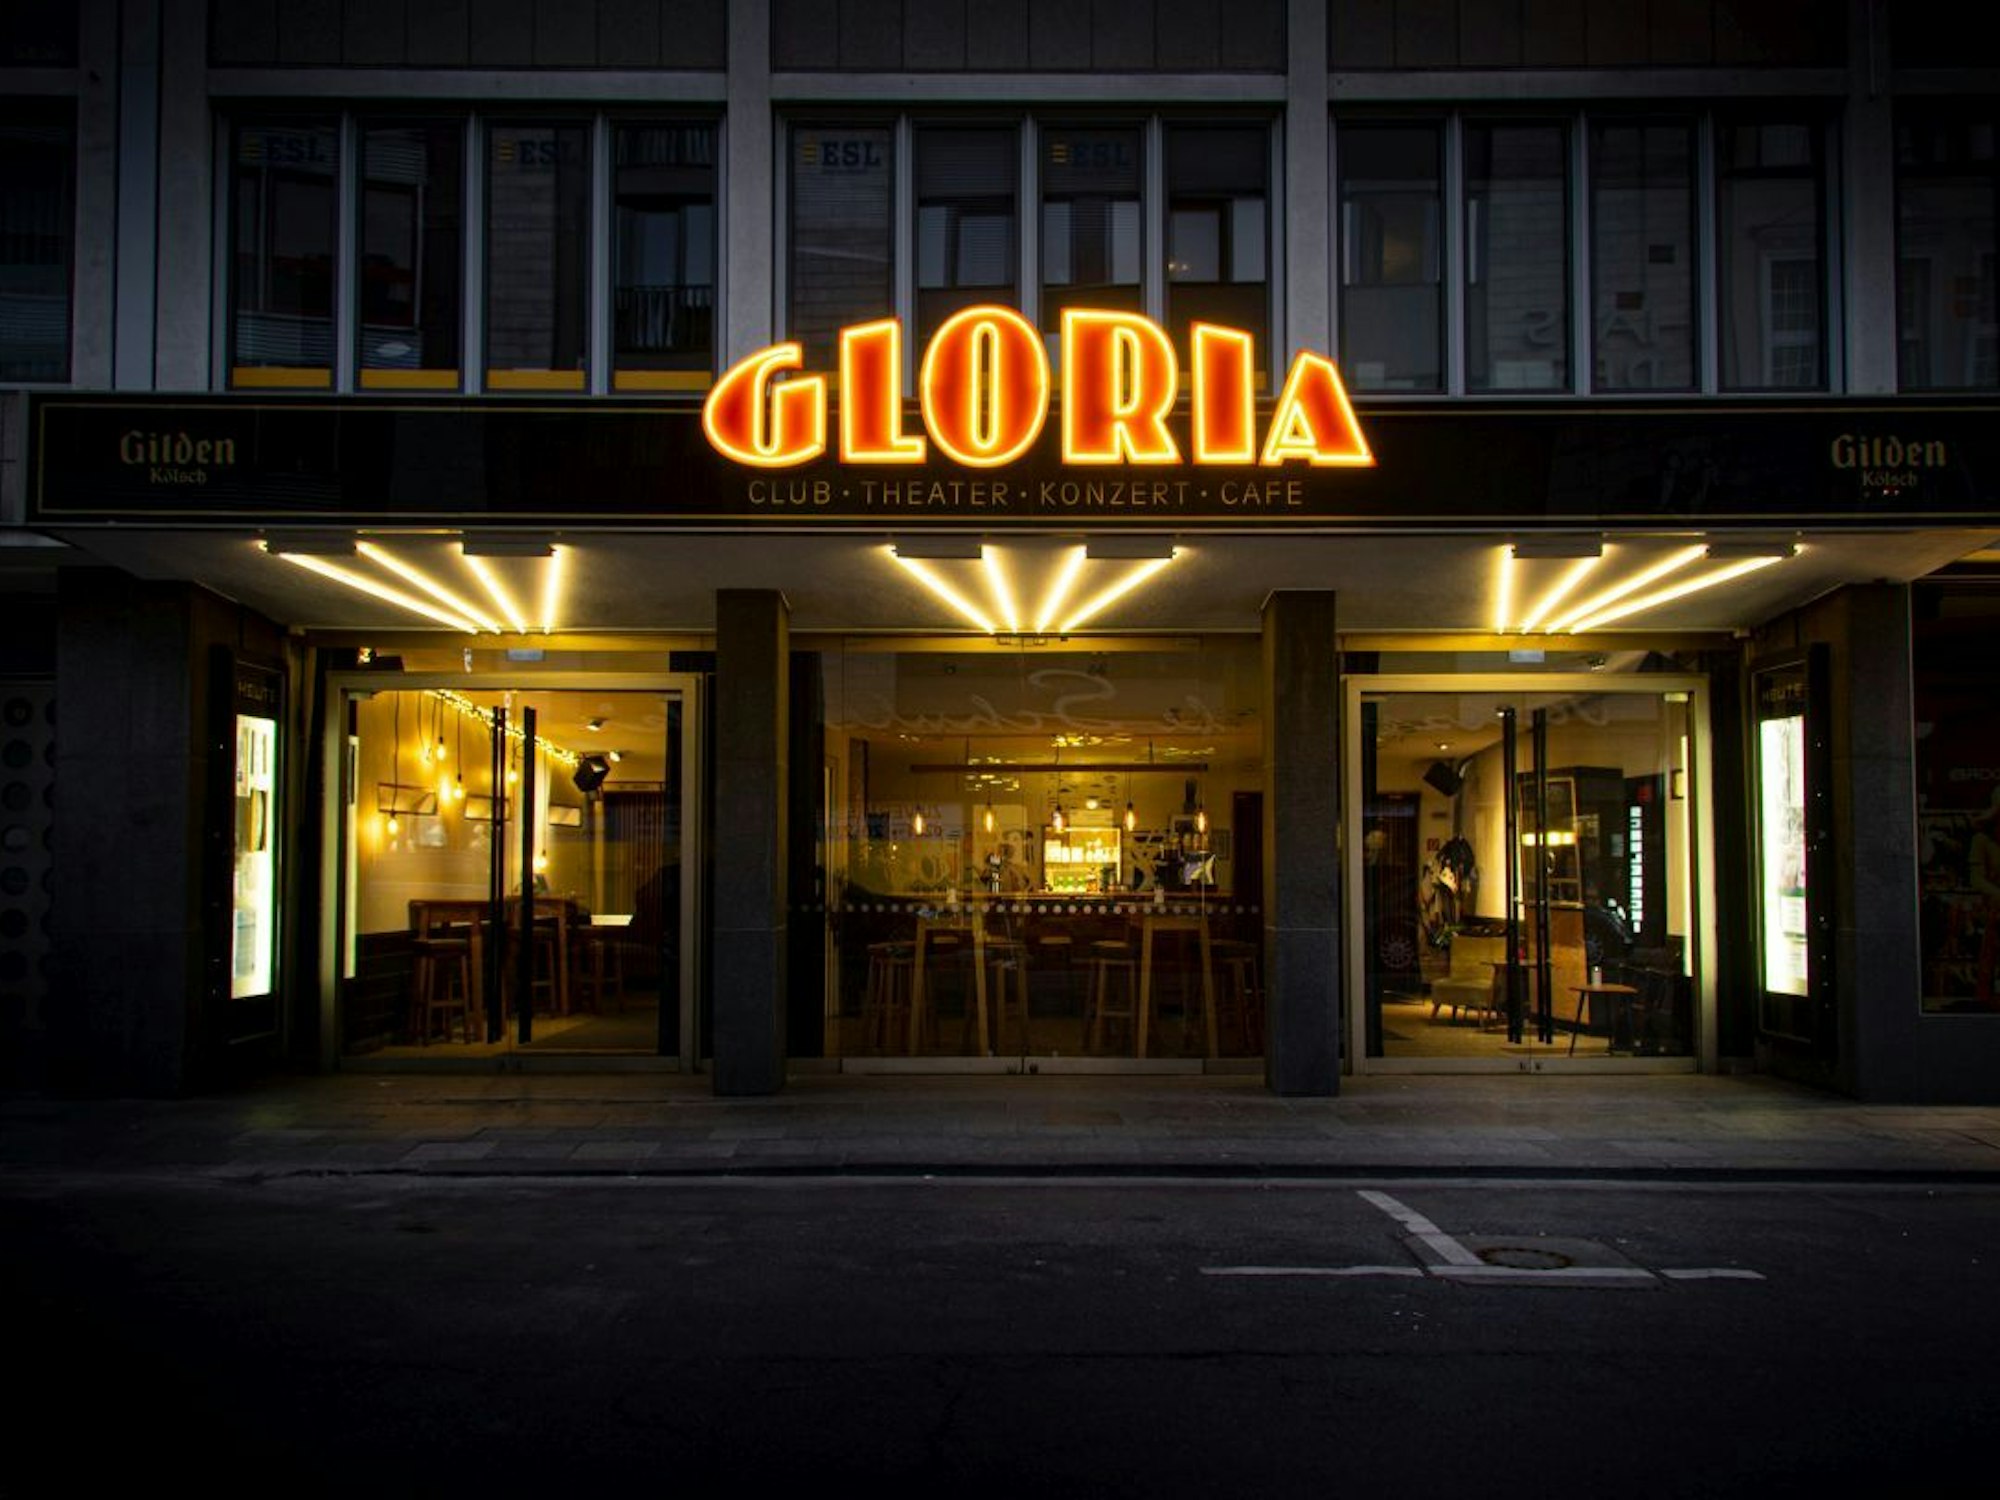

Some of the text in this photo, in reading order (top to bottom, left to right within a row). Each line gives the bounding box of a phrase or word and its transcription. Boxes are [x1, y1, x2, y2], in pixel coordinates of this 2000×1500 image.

[267, 135, 325, 162] ESL
[821, 140, 882, 166] ESL
[702, 304, 1377, 469] GLORIA
[119, 429, 236, 465] Gilden
[1831, 433, 1947, 468] Gilden
[149, 466, 207, 486] Kölsch
[1862, 469, 1920, 488] Kölsch
[749, 480, 1304, 506] CLUB THEATER KONZERT CAFE
